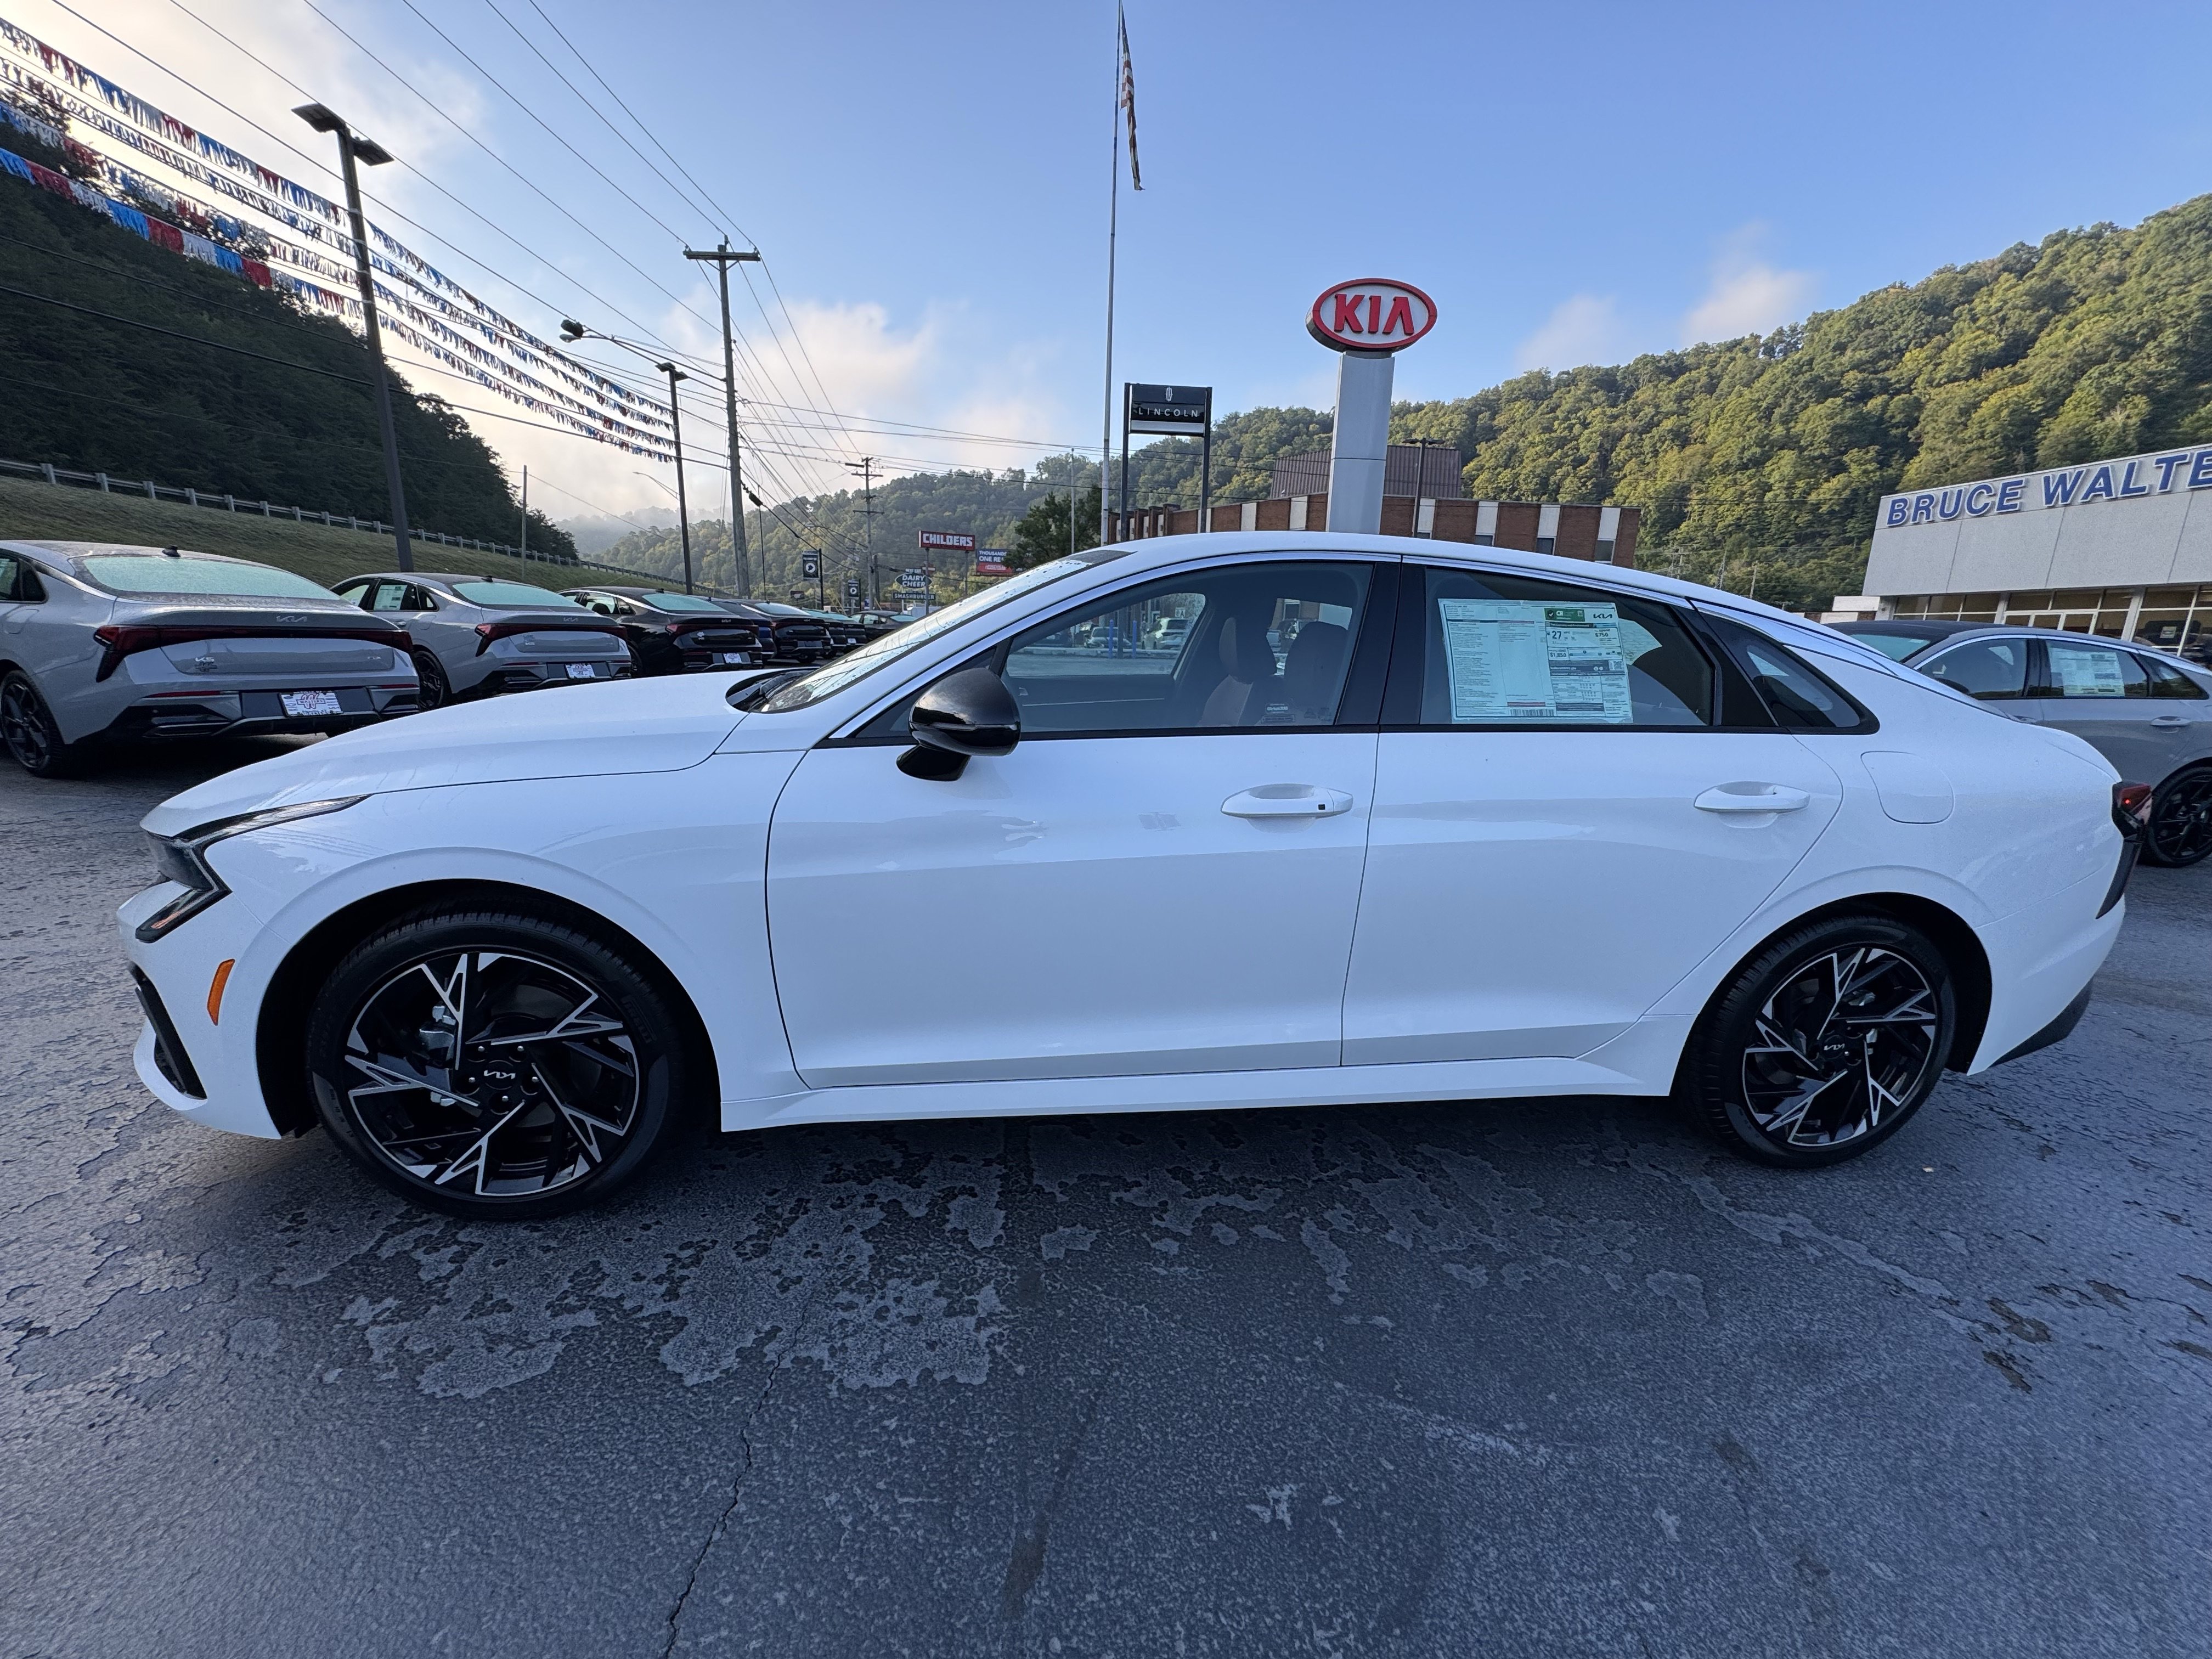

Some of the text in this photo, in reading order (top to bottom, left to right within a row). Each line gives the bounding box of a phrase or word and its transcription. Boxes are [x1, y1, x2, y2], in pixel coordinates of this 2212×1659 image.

[1334, 294, 1415, 336] KIA
[1138, 407, 1198, 417] LINCOLN
[1886, 478, 2025, 528] BRUCE
[923, 533, 973, 547] CHILDERS
[1551, 630, 1562, 639] 27
